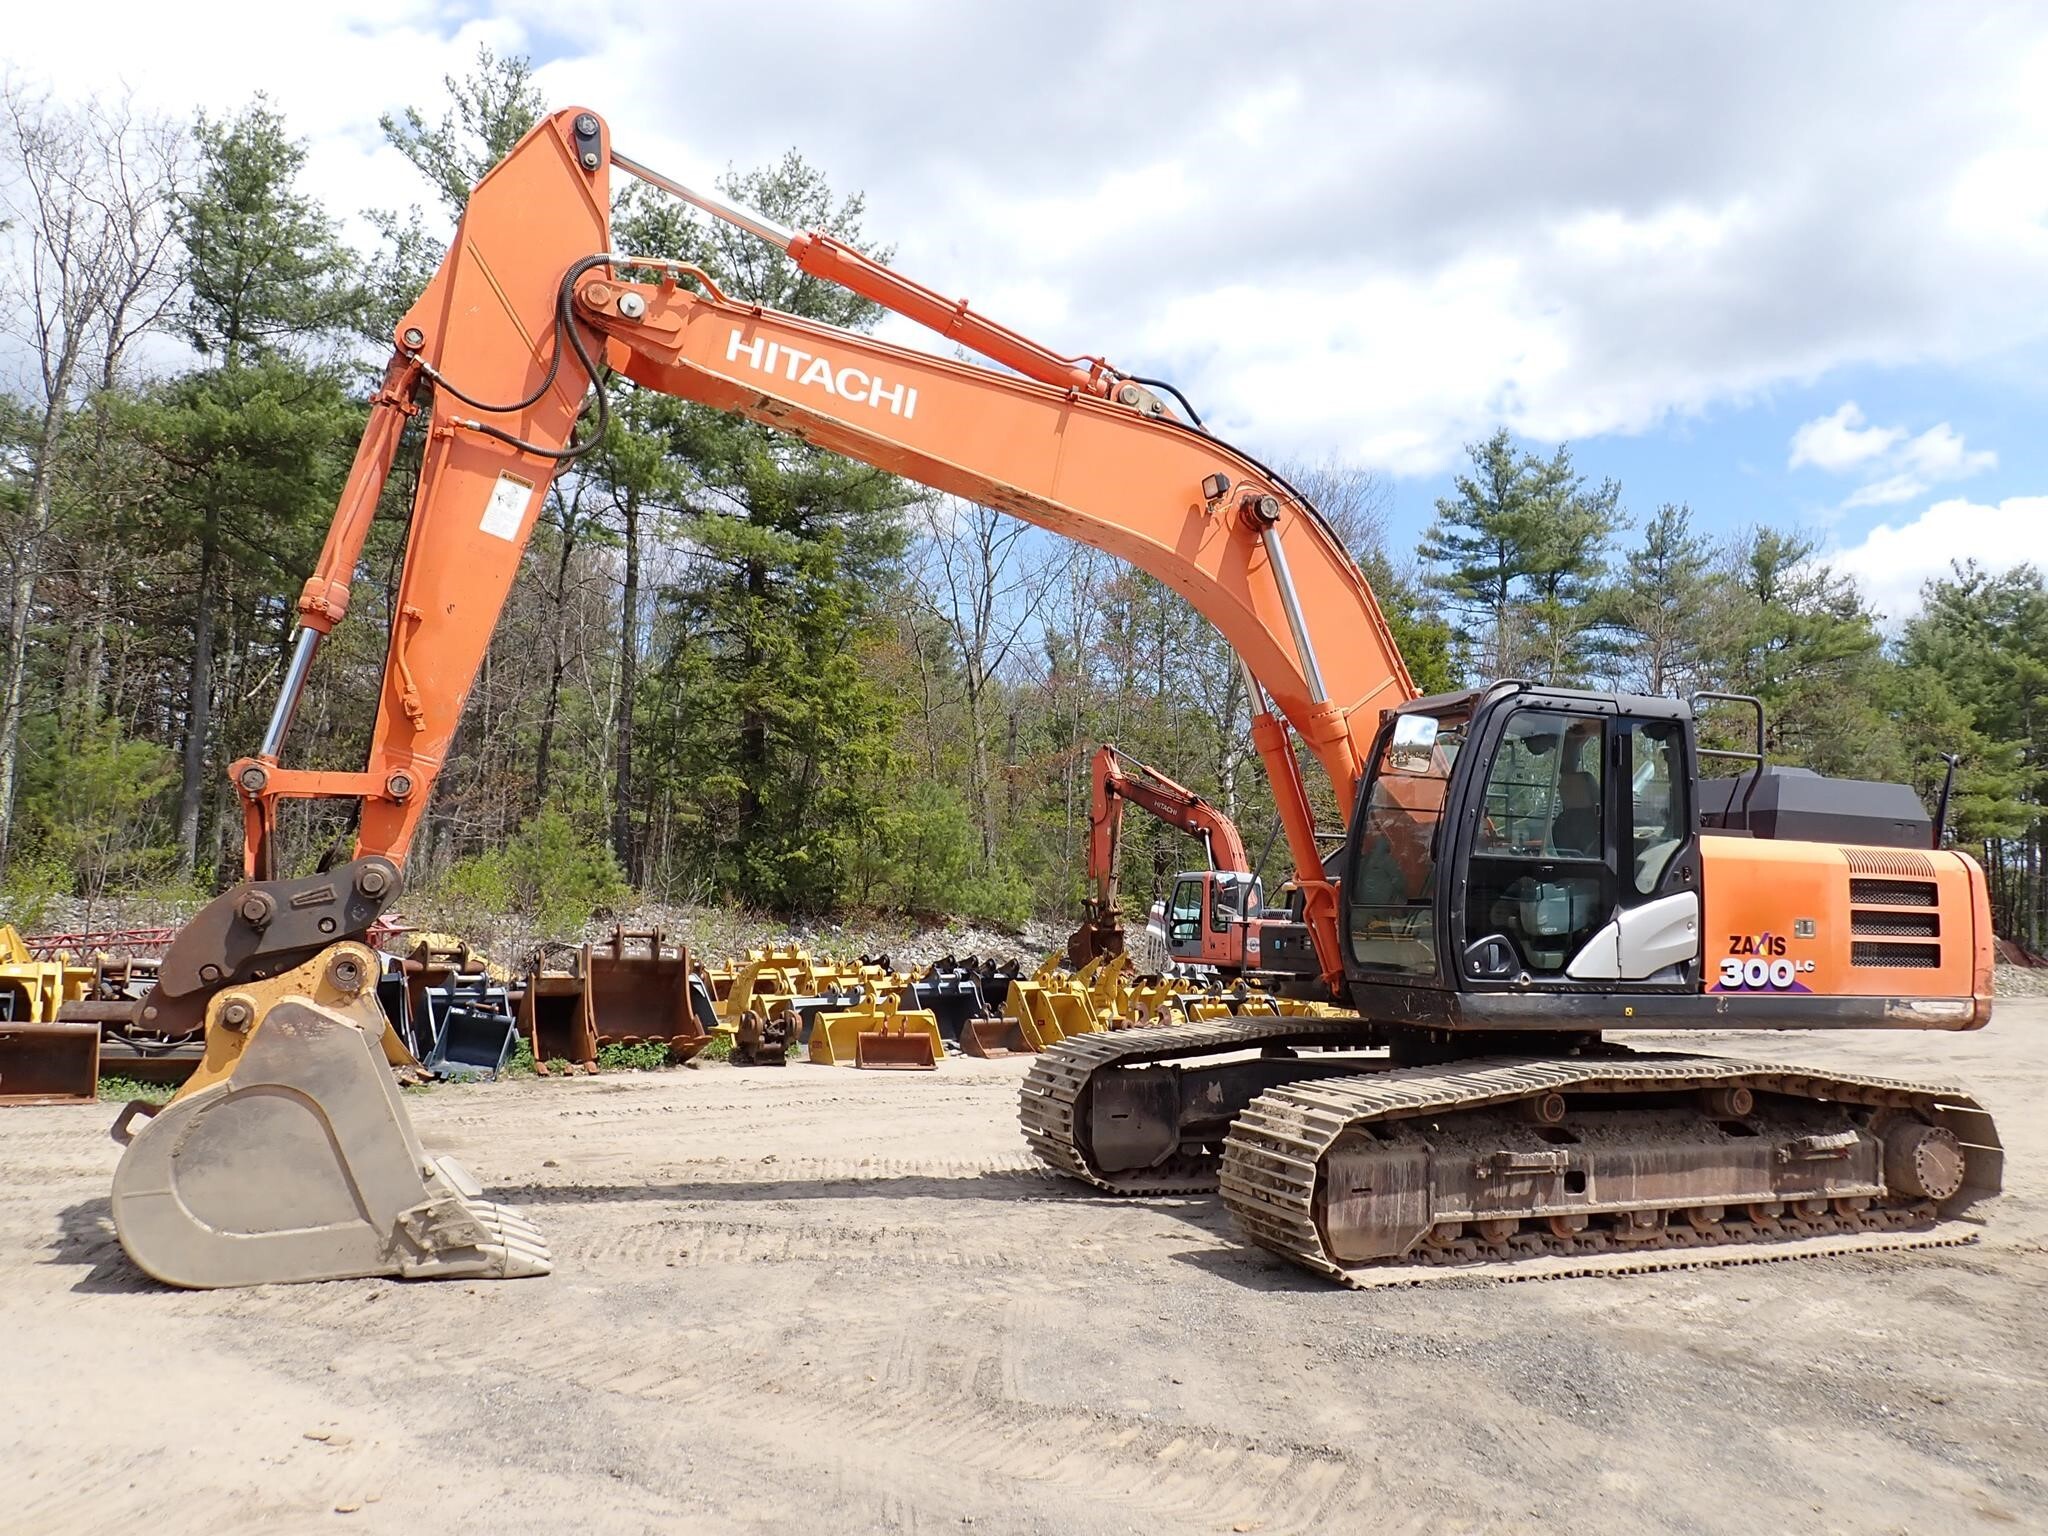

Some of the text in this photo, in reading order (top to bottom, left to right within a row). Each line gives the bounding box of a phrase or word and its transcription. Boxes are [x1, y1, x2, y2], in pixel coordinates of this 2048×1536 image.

[726, 329, 918, 420] HITACHI
[1154, 800, 1178, 816] HITACHI
[1729, 932, 1786, 956] ZAXIS
